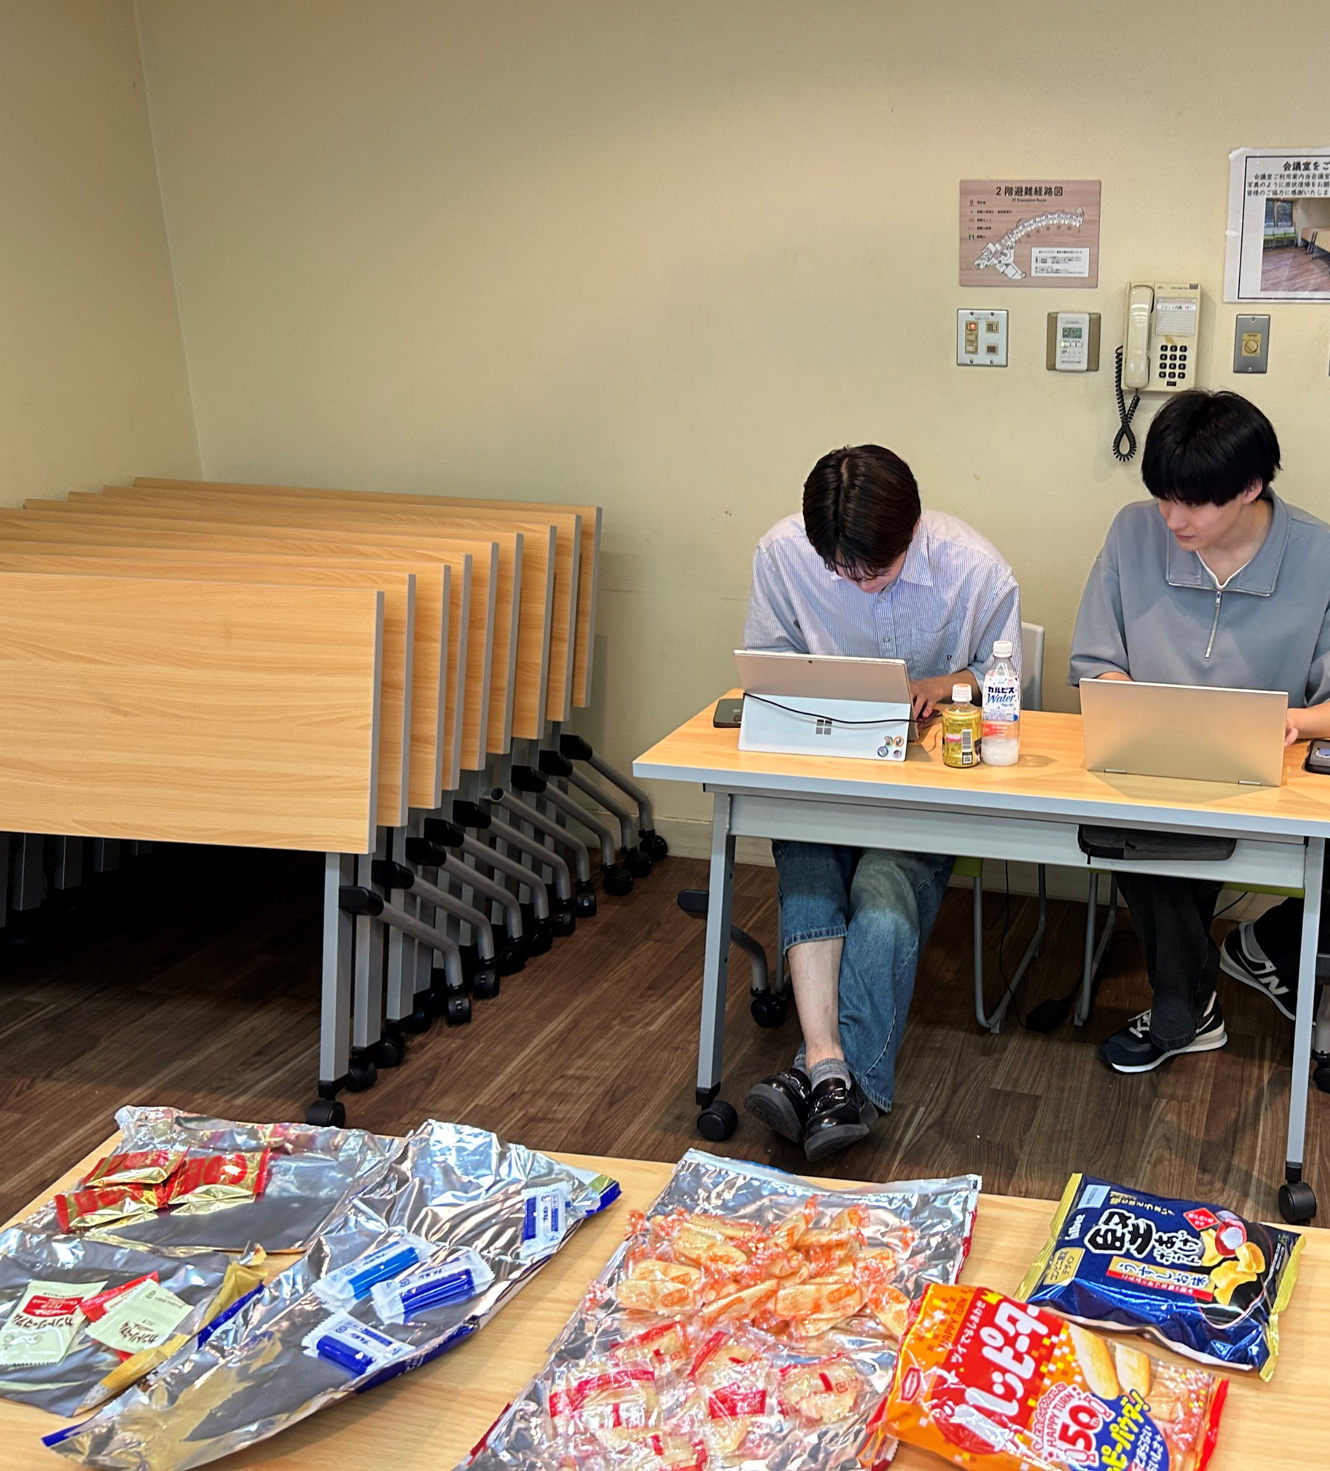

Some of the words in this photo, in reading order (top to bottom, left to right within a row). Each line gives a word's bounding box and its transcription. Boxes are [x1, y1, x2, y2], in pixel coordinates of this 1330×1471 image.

[986, 693, 1016, 704] Water
[988, 686, 1015, 694] カルピス
[1116, 1262, 1210, 1288] うすしお味
[954, 1297, 969, 1323] TURN
[12, 1313, 74, 1329] カントリーマアム
[950, 1298, 987, 1364] ツイでるしあわせ
